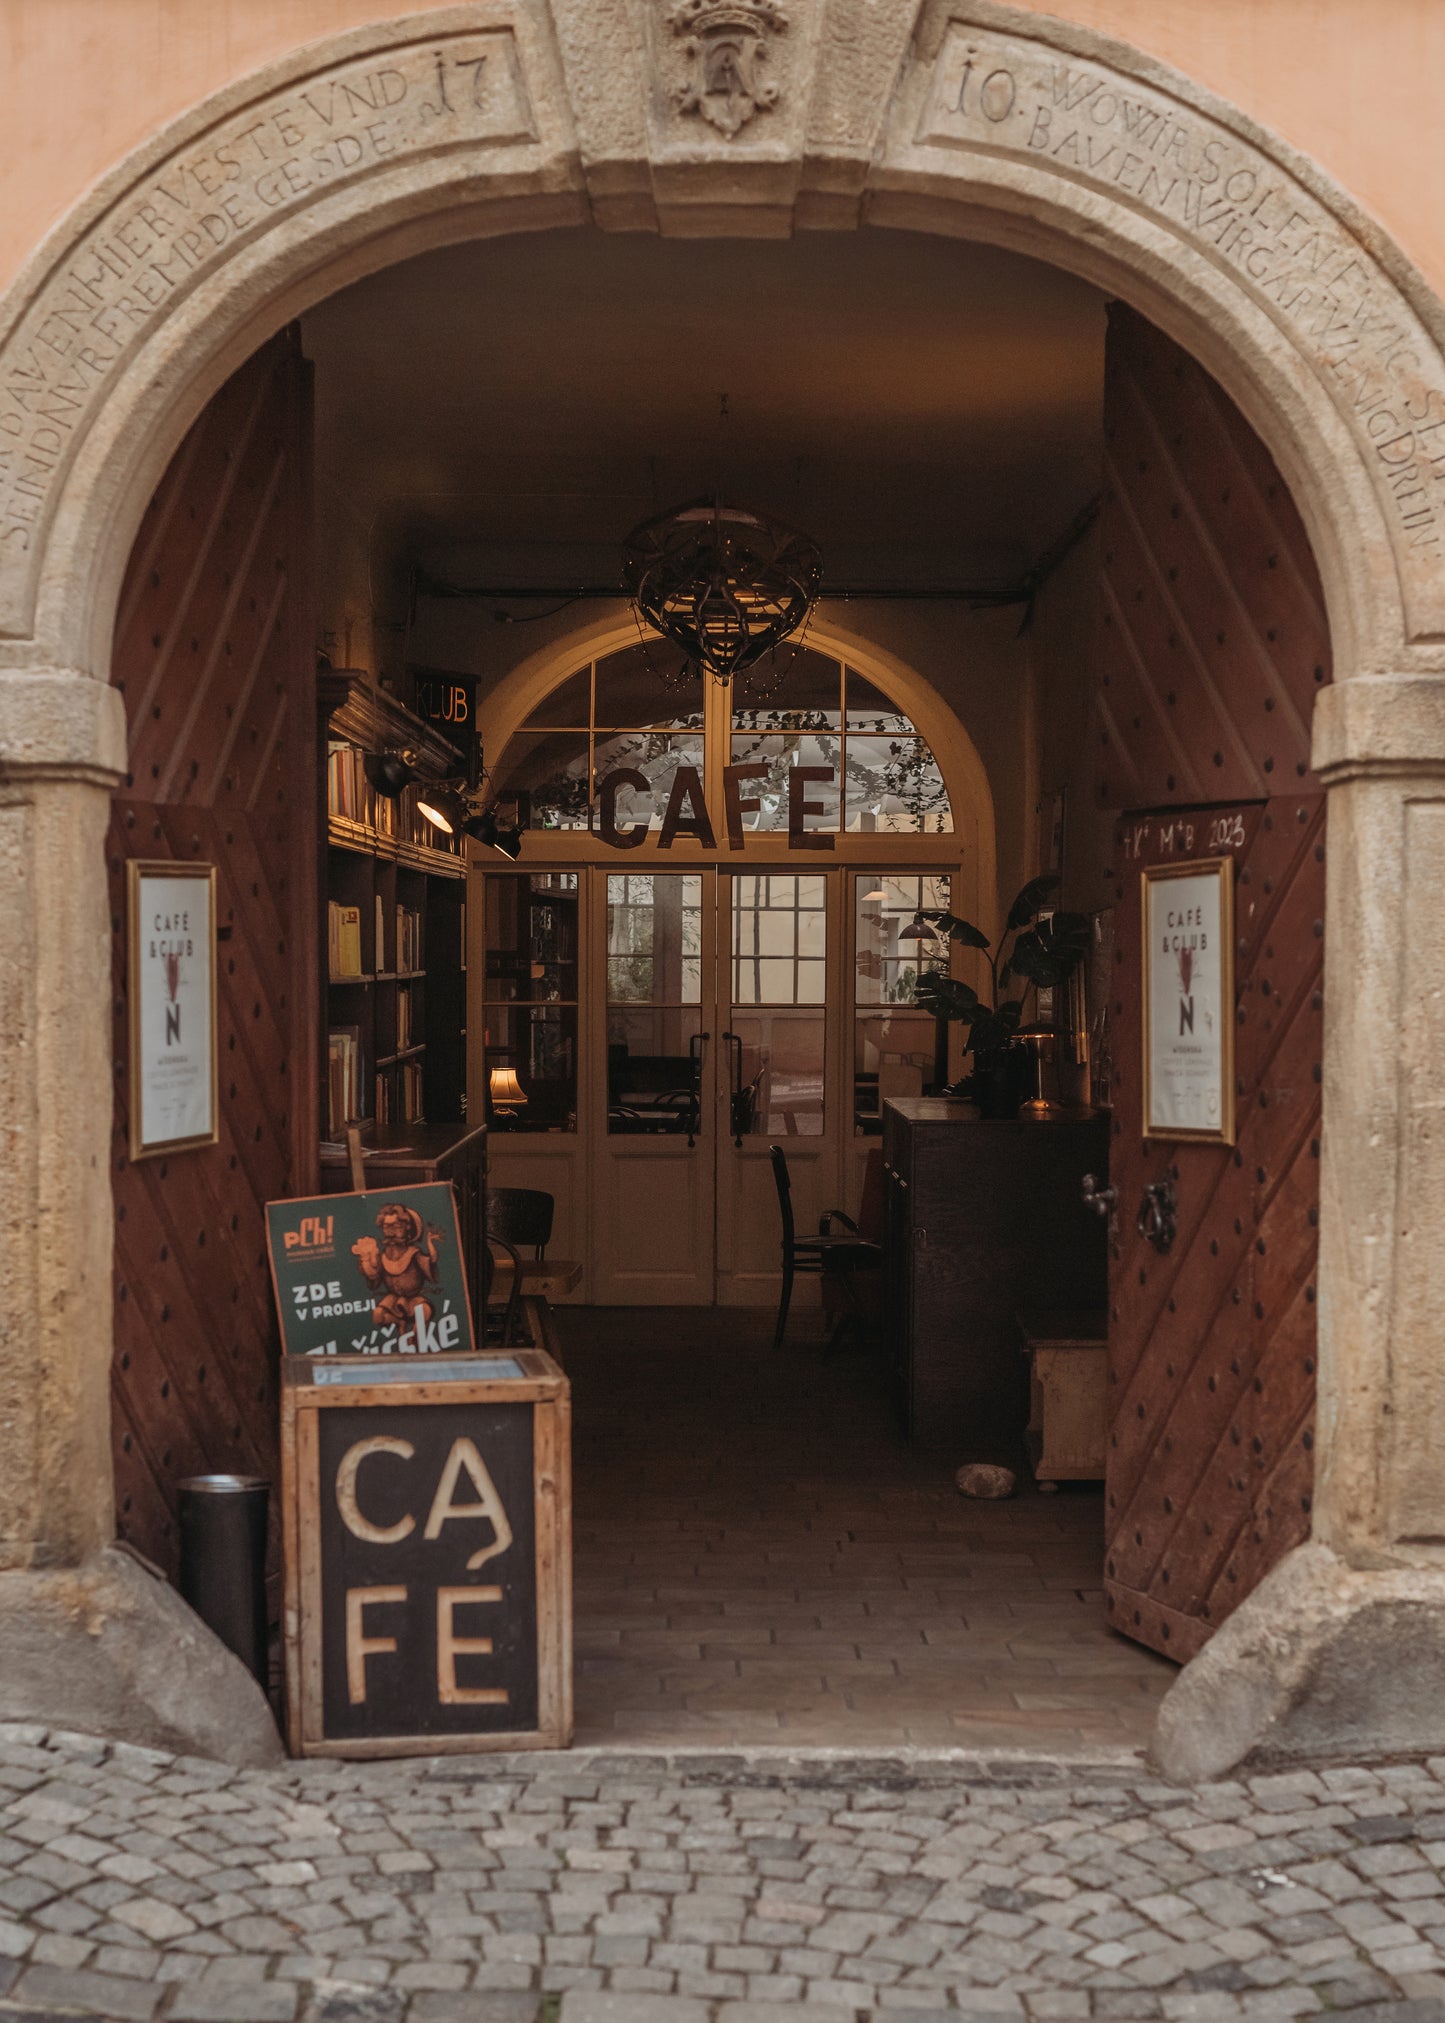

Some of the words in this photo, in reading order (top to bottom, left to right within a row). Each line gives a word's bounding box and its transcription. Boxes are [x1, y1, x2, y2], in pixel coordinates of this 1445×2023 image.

[416, 680, 468, 722] KLUB
[592, 765, 835, 852] CAFE
[154, 911, 190, 932] CAFÉ
[1167, 905, 1201, 928] CAFÉ
[165, 1003, 181, 1046] N
[1180, 996, 1194, 1036] N
[293, 1281, 343, 1304] ZDE
[296, 1309, 308, 1321] V
[313, 1299, 376, 1319] PRODEJI
